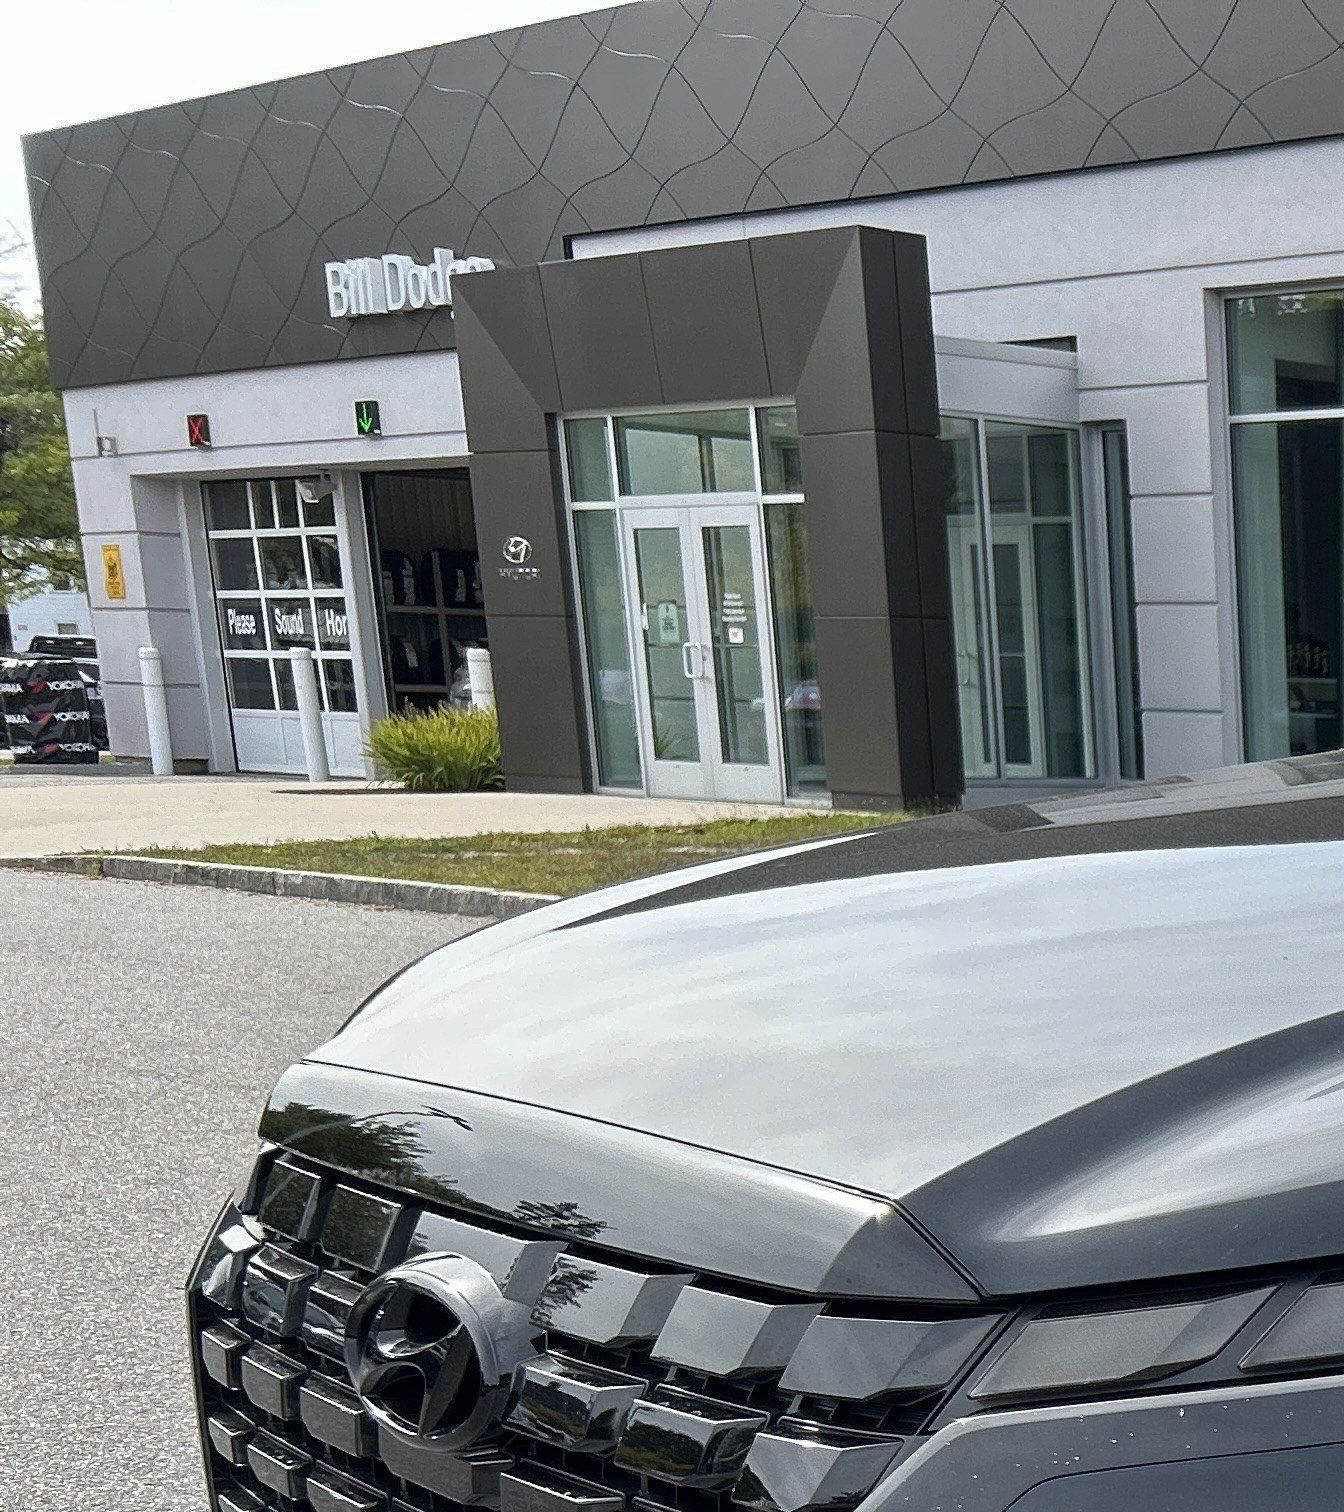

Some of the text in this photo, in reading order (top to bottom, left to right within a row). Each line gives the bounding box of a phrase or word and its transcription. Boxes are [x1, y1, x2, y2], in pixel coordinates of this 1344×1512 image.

[325, 247, 495, 319] Bill Dod
[227, 608, 257, 636] Please
[274, 608, 305, 636] Sound
